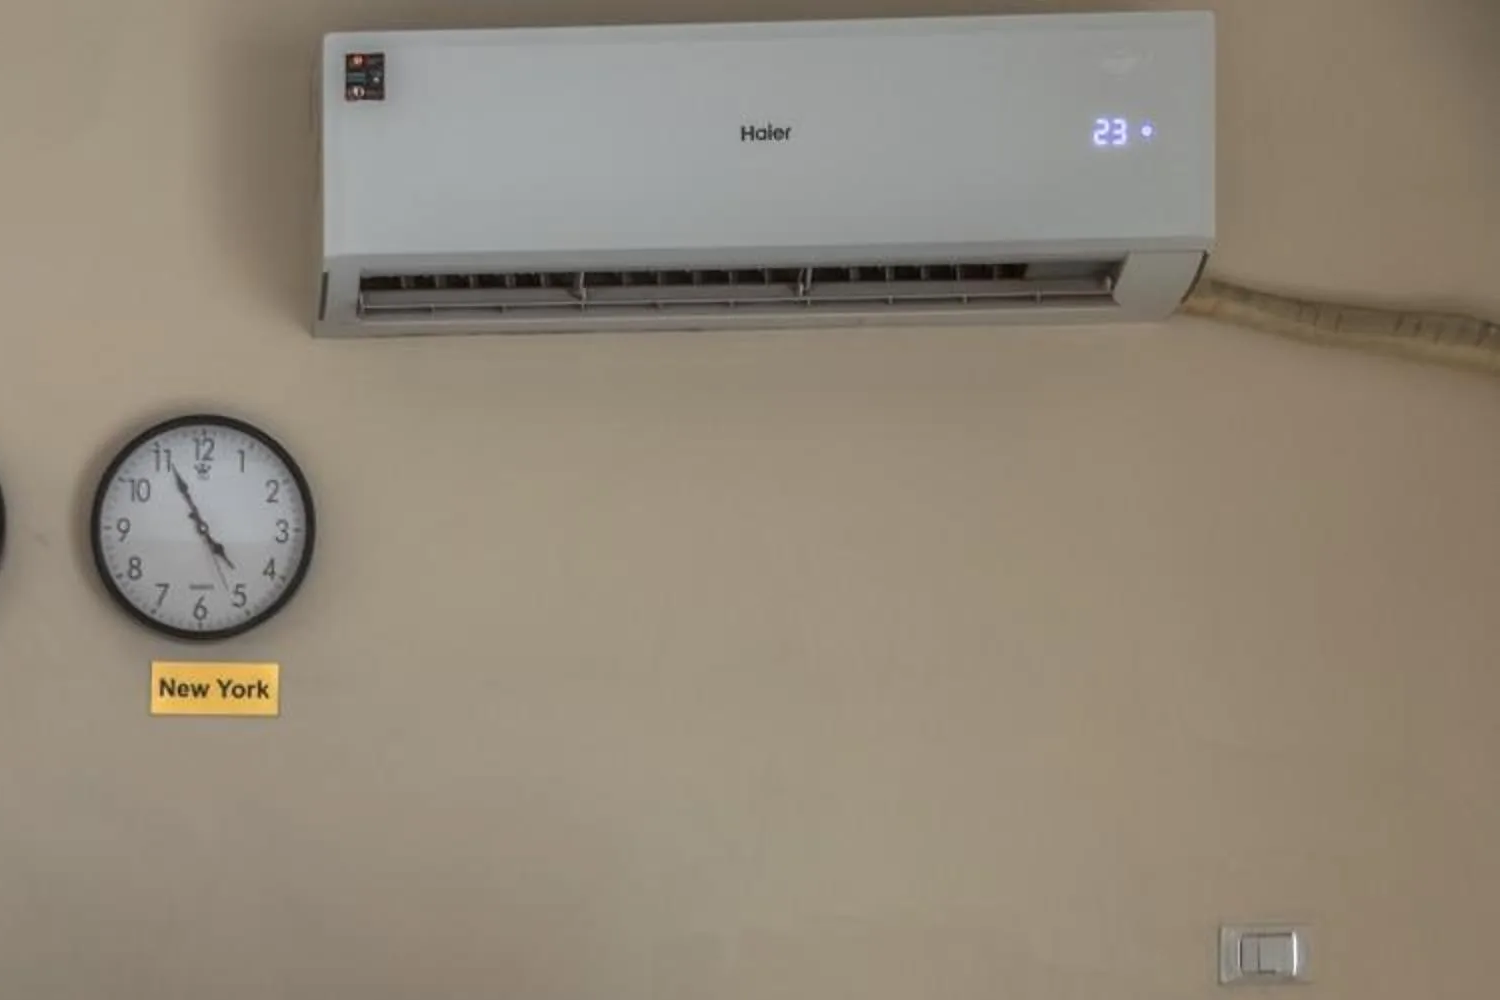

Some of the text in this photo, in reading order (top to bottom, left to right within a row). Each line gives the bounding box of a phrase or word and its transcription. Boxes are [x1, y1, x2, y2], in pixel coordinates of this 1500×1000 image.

[741, 123, 792, 141] Haier
[1093, 118, 1127, 145] 23
[152, 448, 172, 473] 11
[192, 437, 216, 462] 12
[236, 449, 245, 474] 1
[128, 478, 151, 503] 10
[265, 479, 280, 504] 2
[116, 517, 131, 543] 9
[274, 519, 290, 544] 3
[127, 556, 143, 581] 8
[262, 557, 276, 581] 4
[154, 583, 170, 608] 7
[231, 583, 248, 608] 5
[192, 596, 208, 621] 6
[159, 677, 270, 699] New York
